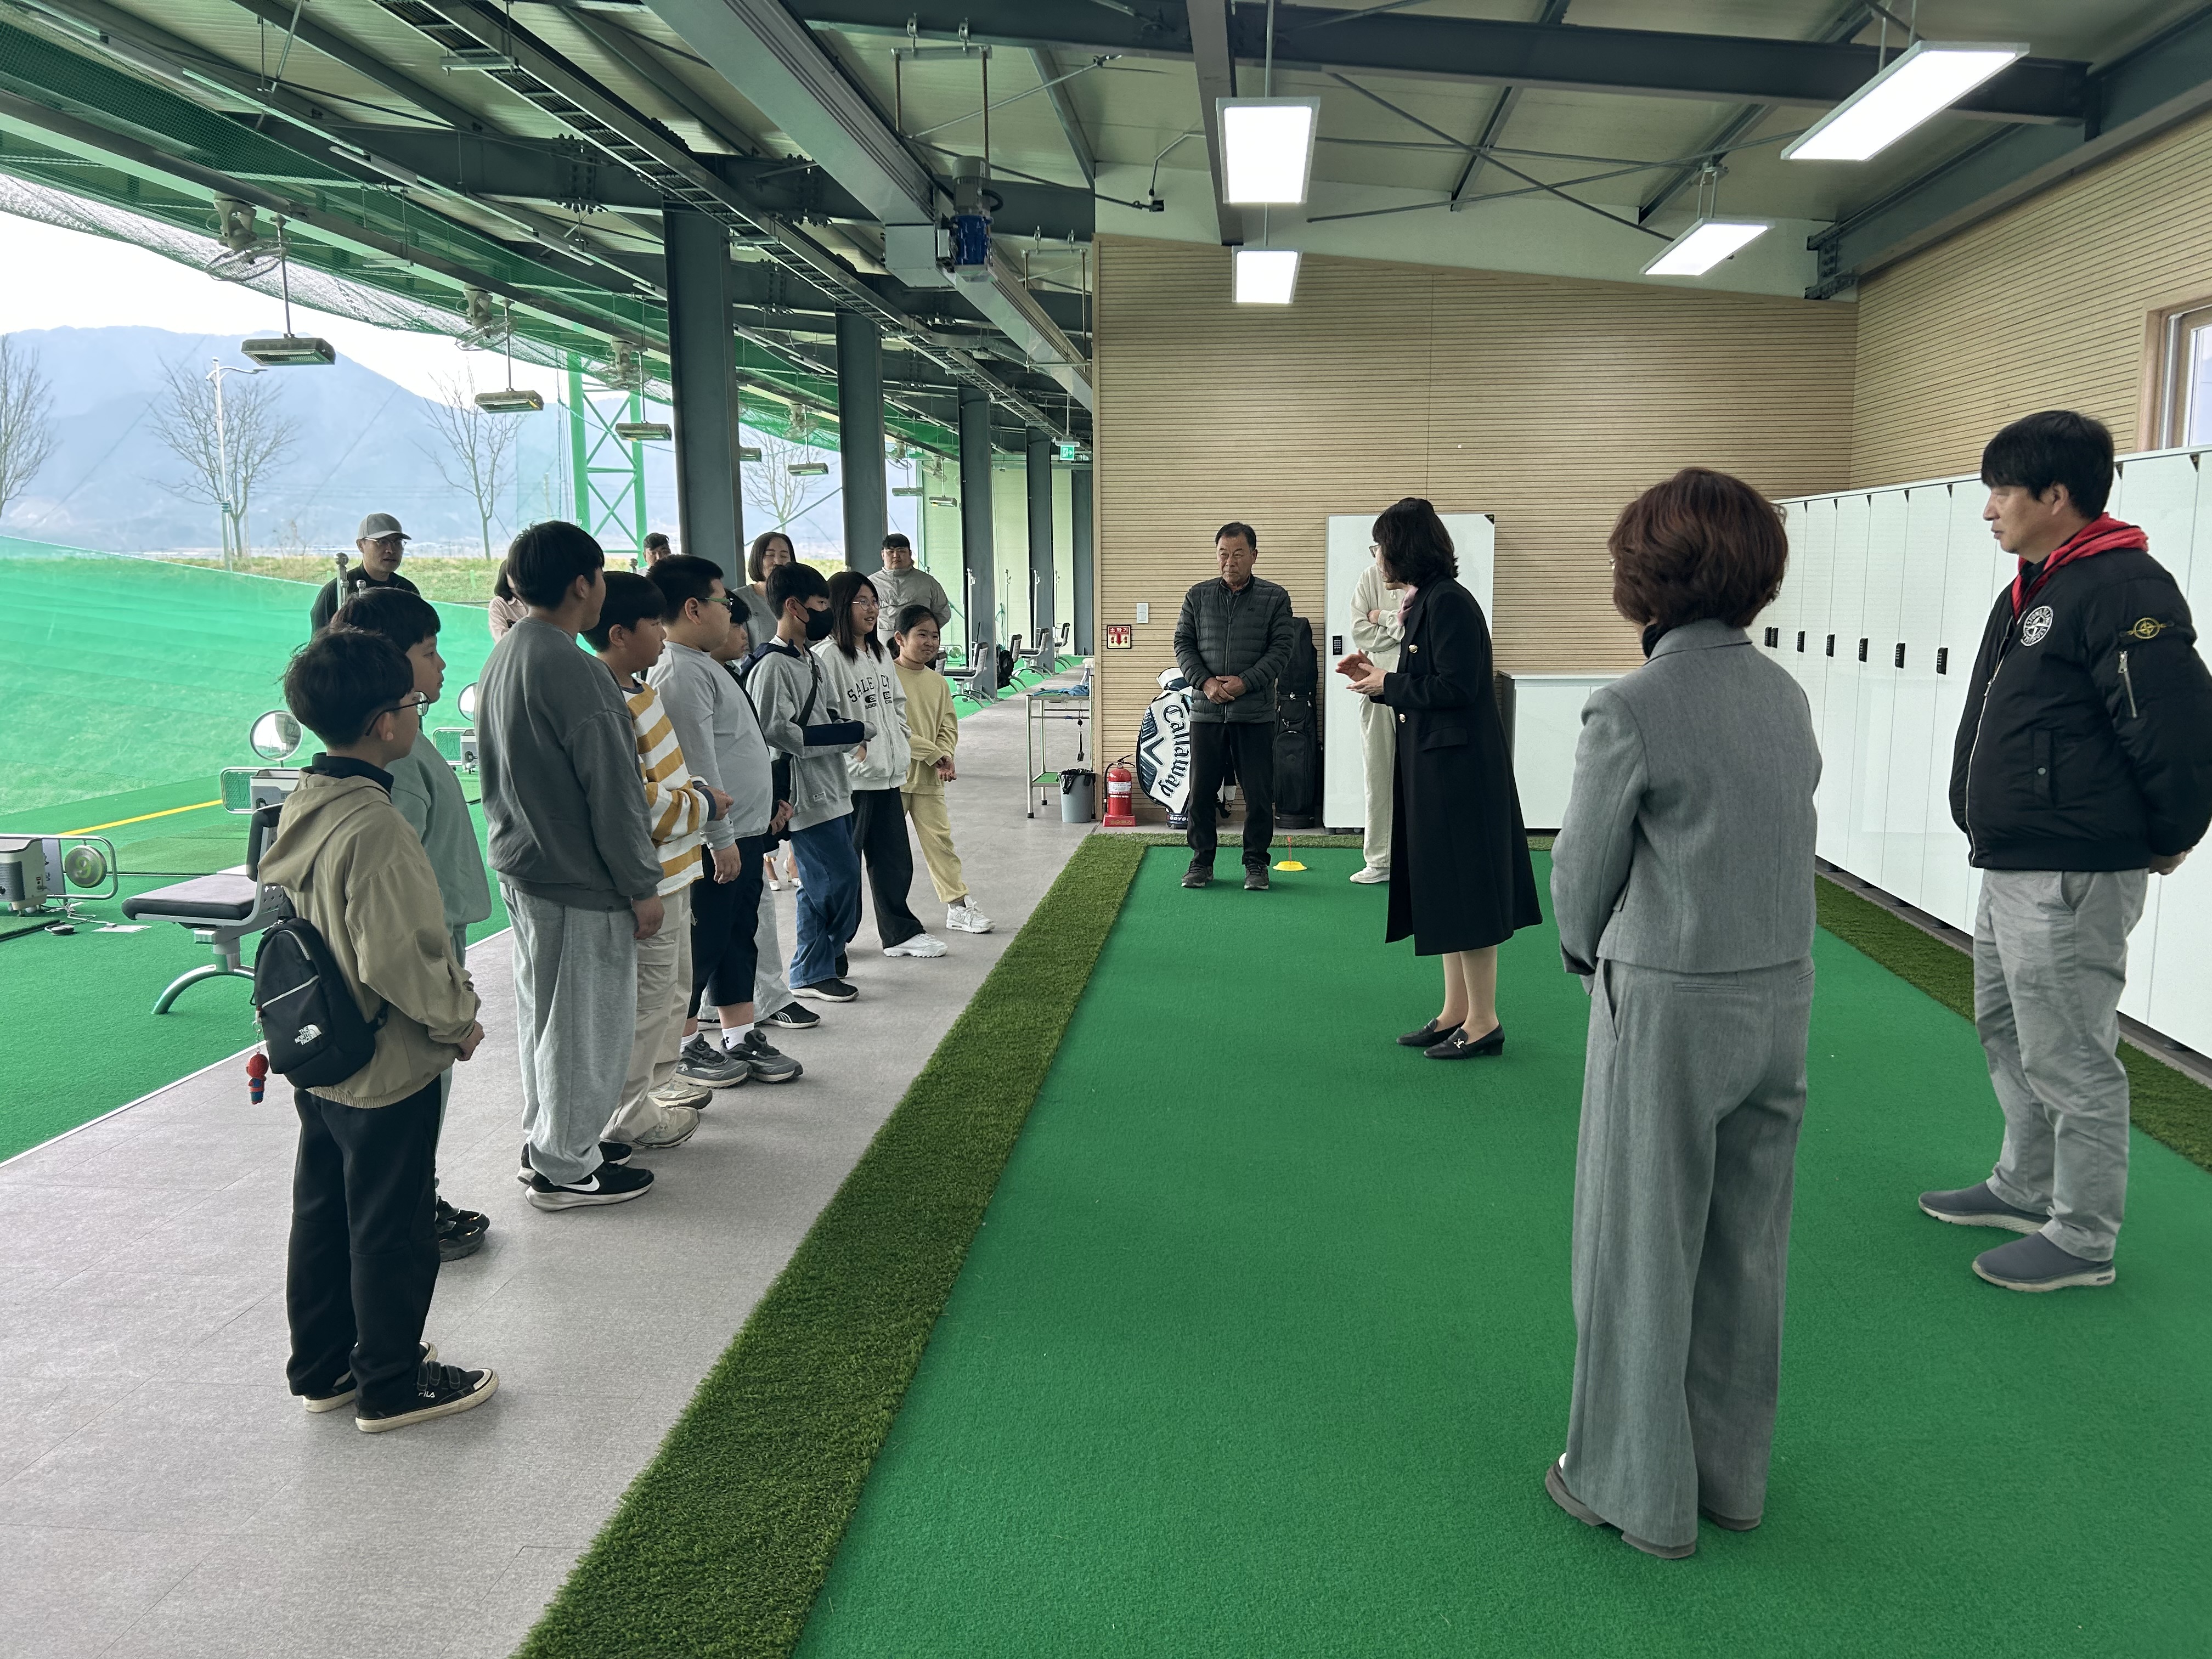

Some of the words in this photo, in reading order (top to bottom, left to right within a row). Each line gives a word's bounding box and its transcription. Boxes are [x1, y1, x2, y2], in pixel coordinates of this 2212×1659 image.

[1158, 705, 1190, 797] Callaway
[298, 1026, 308, 1035] THE
[295, 1031, 311, 1043] NORTH
[301, 1034, 314, 1046] FACE
